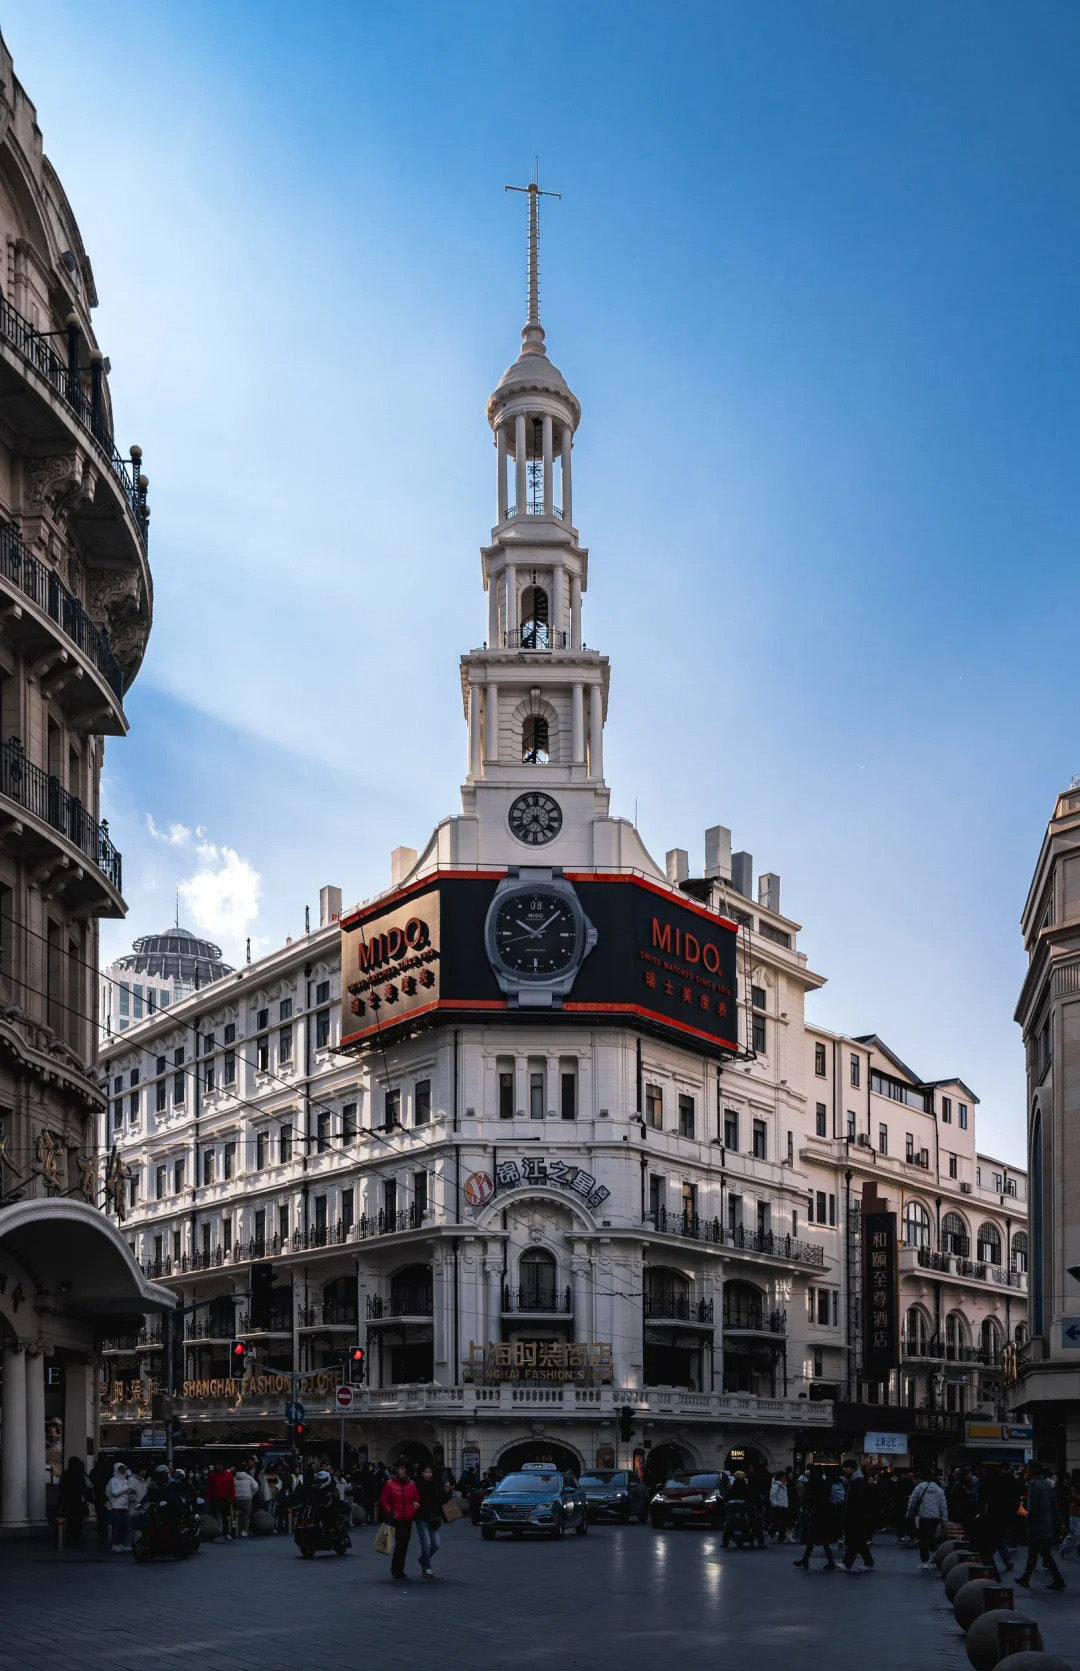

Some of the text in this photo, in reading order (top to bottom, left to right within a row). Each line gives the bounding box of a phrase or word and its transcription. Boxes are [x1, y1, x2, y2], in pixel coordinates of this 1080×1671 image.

[652, 917, 721, 974] MIDO
[496, 1157, 597, 1198] 锦江之星
[872, 1231, 889, 1349] 和颐至尊酒店
[462, 1340, 615, 1367] 上海时装商店
[182, 1377, 240, 1398] SHANGHAI
[525, 1369, 573, 1381] FASHION
